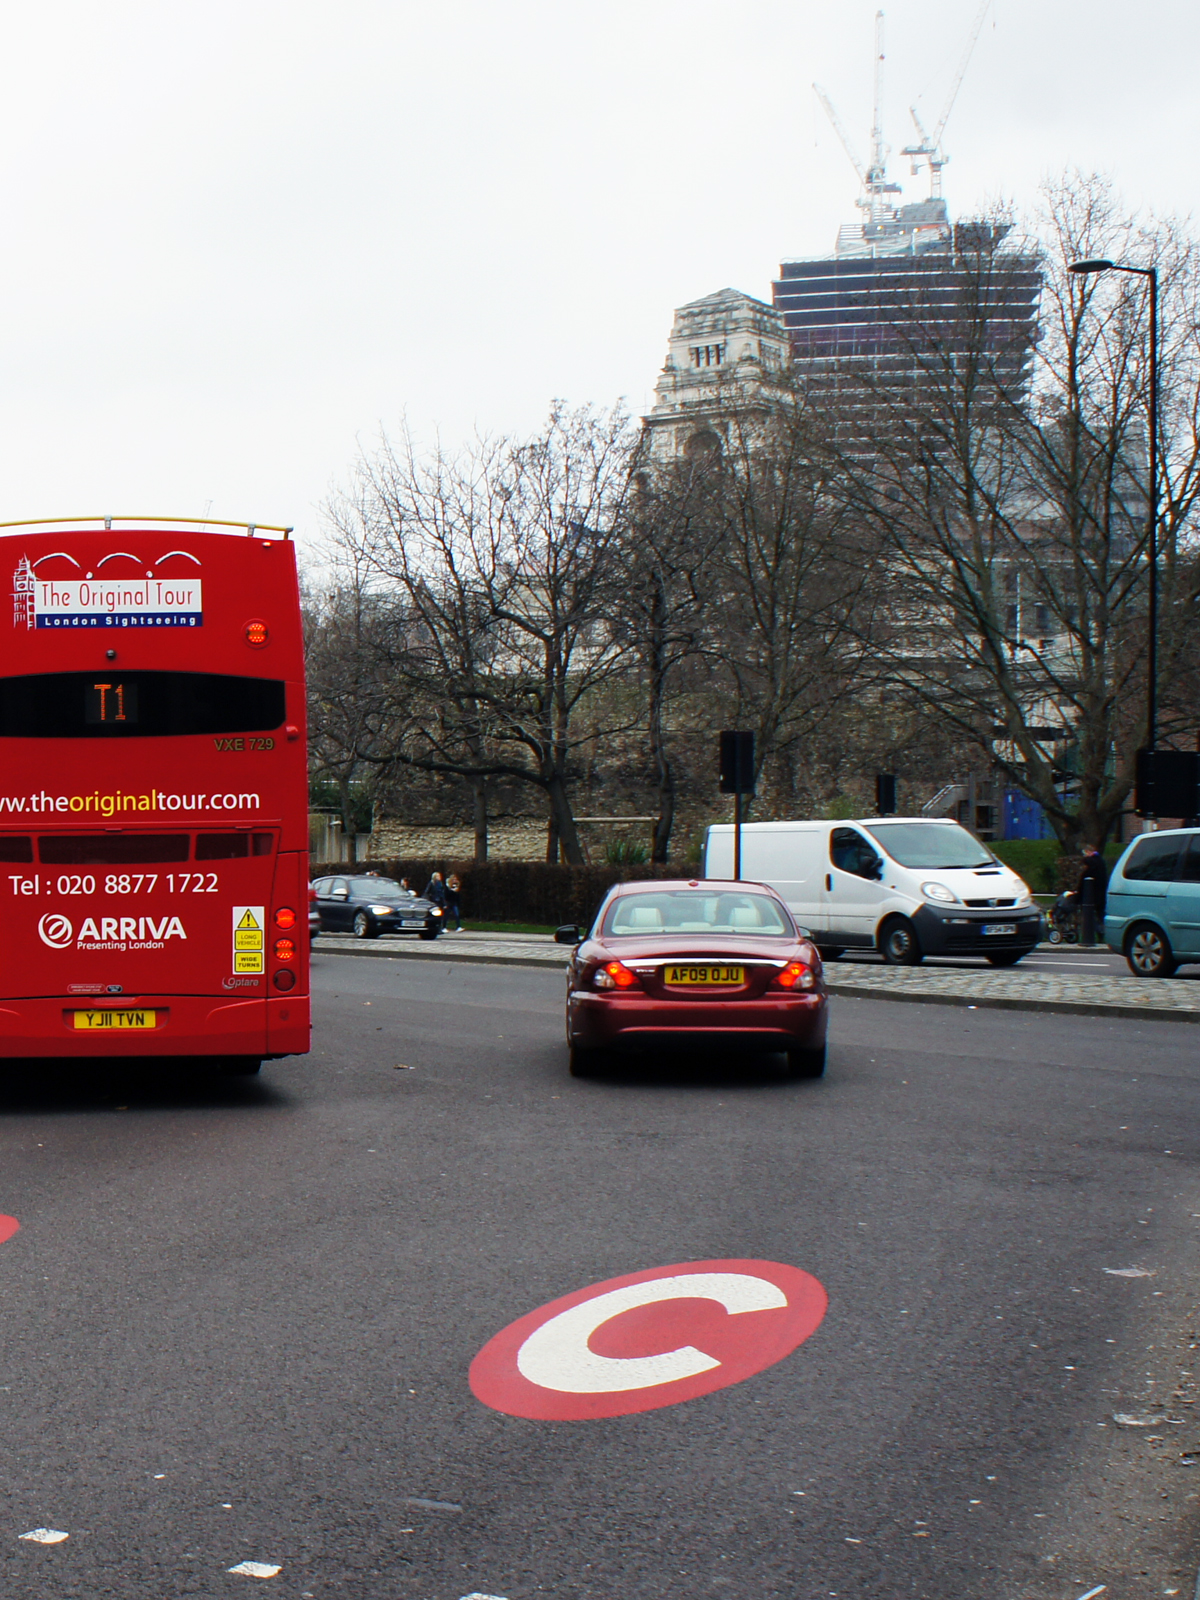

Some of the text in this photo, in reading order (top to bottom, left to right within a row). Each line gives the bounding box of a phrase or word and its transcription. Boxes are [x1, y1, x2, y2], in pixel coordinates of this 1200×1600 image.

[42, 581, 194, 612] The Original Tour
[44, 615, 197, 628] London Sightseeing
[94, 683, 126, 722] T1
[213, 737, 275, 752] VXE 729
[8, 874, 40, 896] Tel
[57, 874, 96, 895] 020
[104, 874, 158, 894] 8877
[166, 873, 219, 893] 1722
[77, 916, 187, 940] ARRIVA
[77, 940, 164, 952] Presenting London
[671, 968, 708, 982] AF09
[711, 968, 740, 981] OJU
[227, 977, 260, 988] Optare
[86, 1012, 145, 1026] YJ11 TVN
